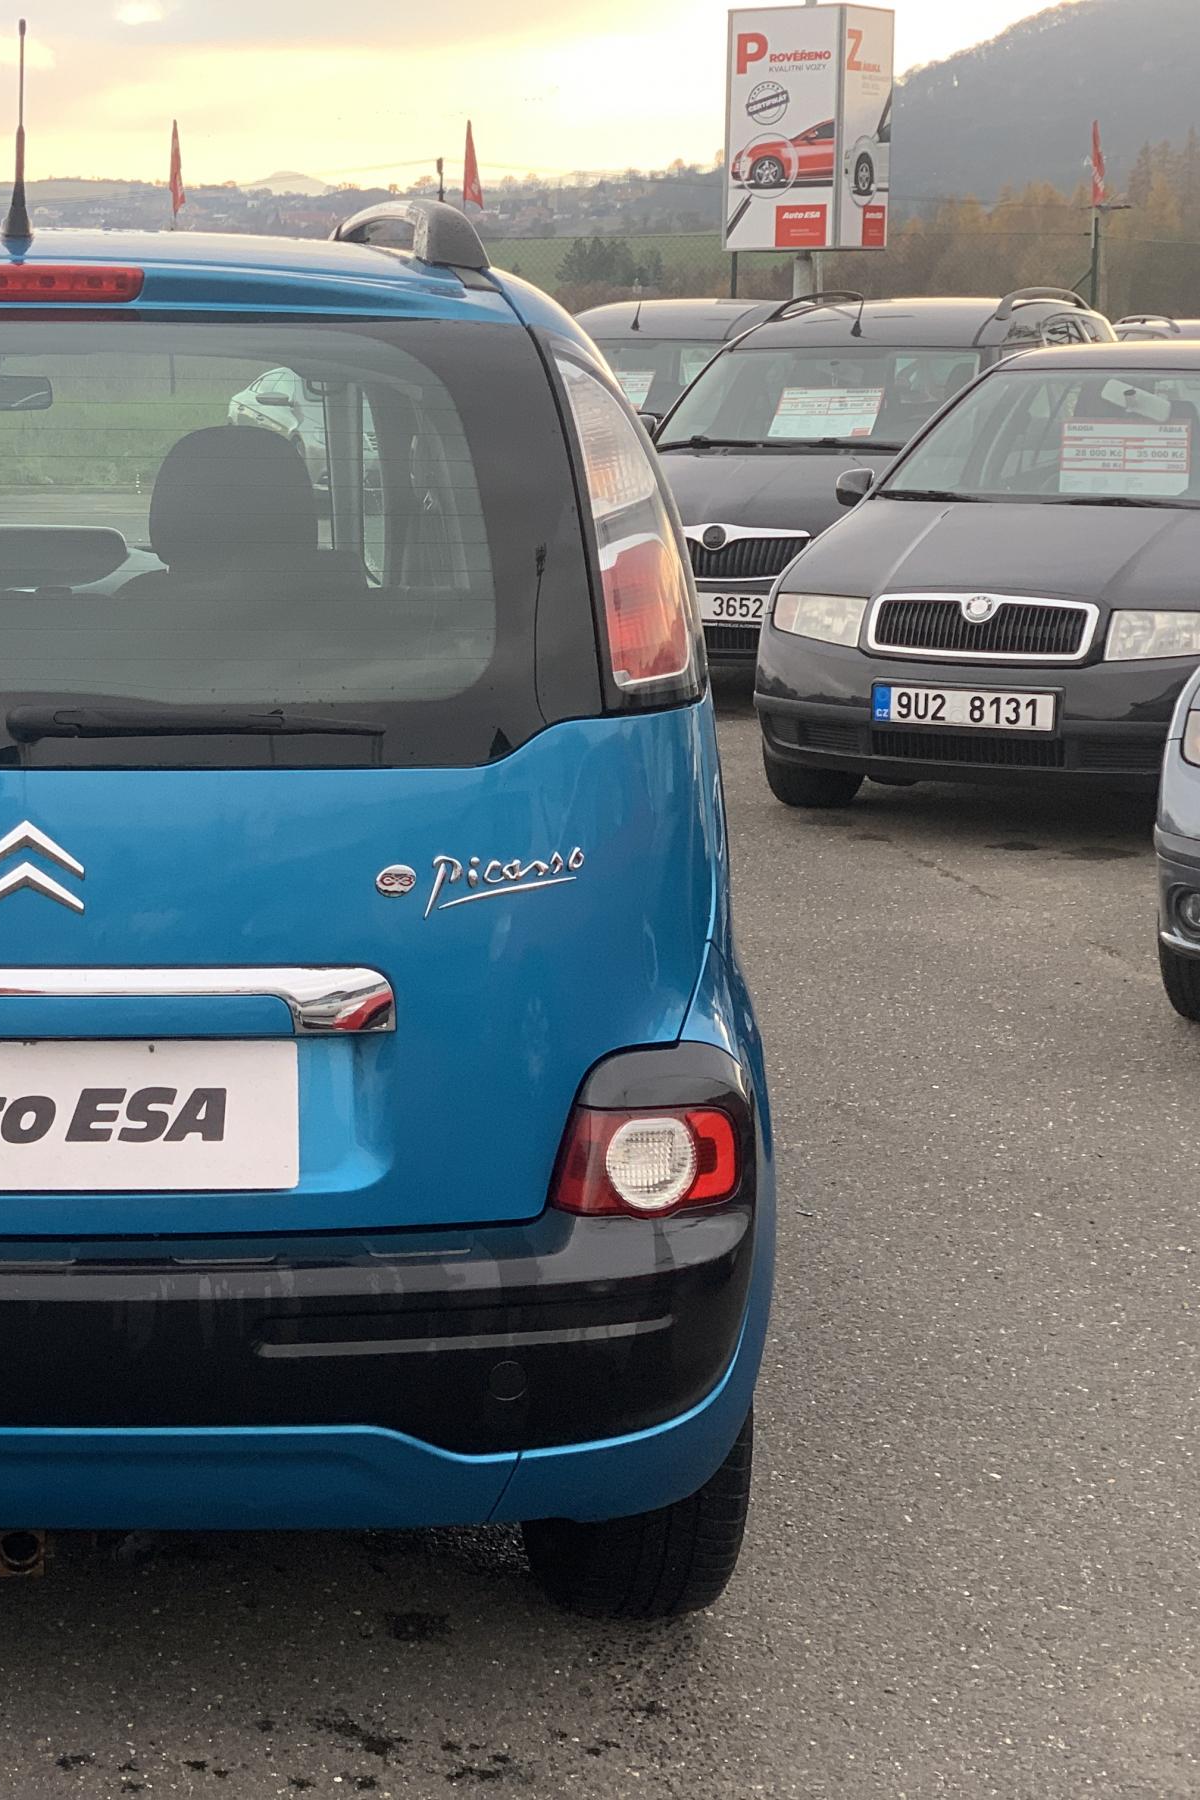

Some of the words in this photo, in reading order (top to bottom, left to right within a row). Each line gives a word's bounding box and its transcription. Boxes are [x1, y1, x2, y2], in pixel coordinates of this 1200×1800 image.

[768, 63, 804, 73] KVALITNÍ
[806, 63, 827, 71] VOZY
[782, 211, 804, 219] Auto
[804, 211, 821, 219] ESA
[1109, 448, 1122, 457] Kč
[1151, 450, 1169, 458] 000
[1171, 450, 1185, 459] Kč
[712, 596, 764, 618] 3652
[875, 708, 889, 718] CZ
[896, 691, 946, 722] 9U2
[968, 695, 1038, 727] 8131
[423, 846, 585, 920] Picasso
[64, 1086, 228, 1143] ESA
